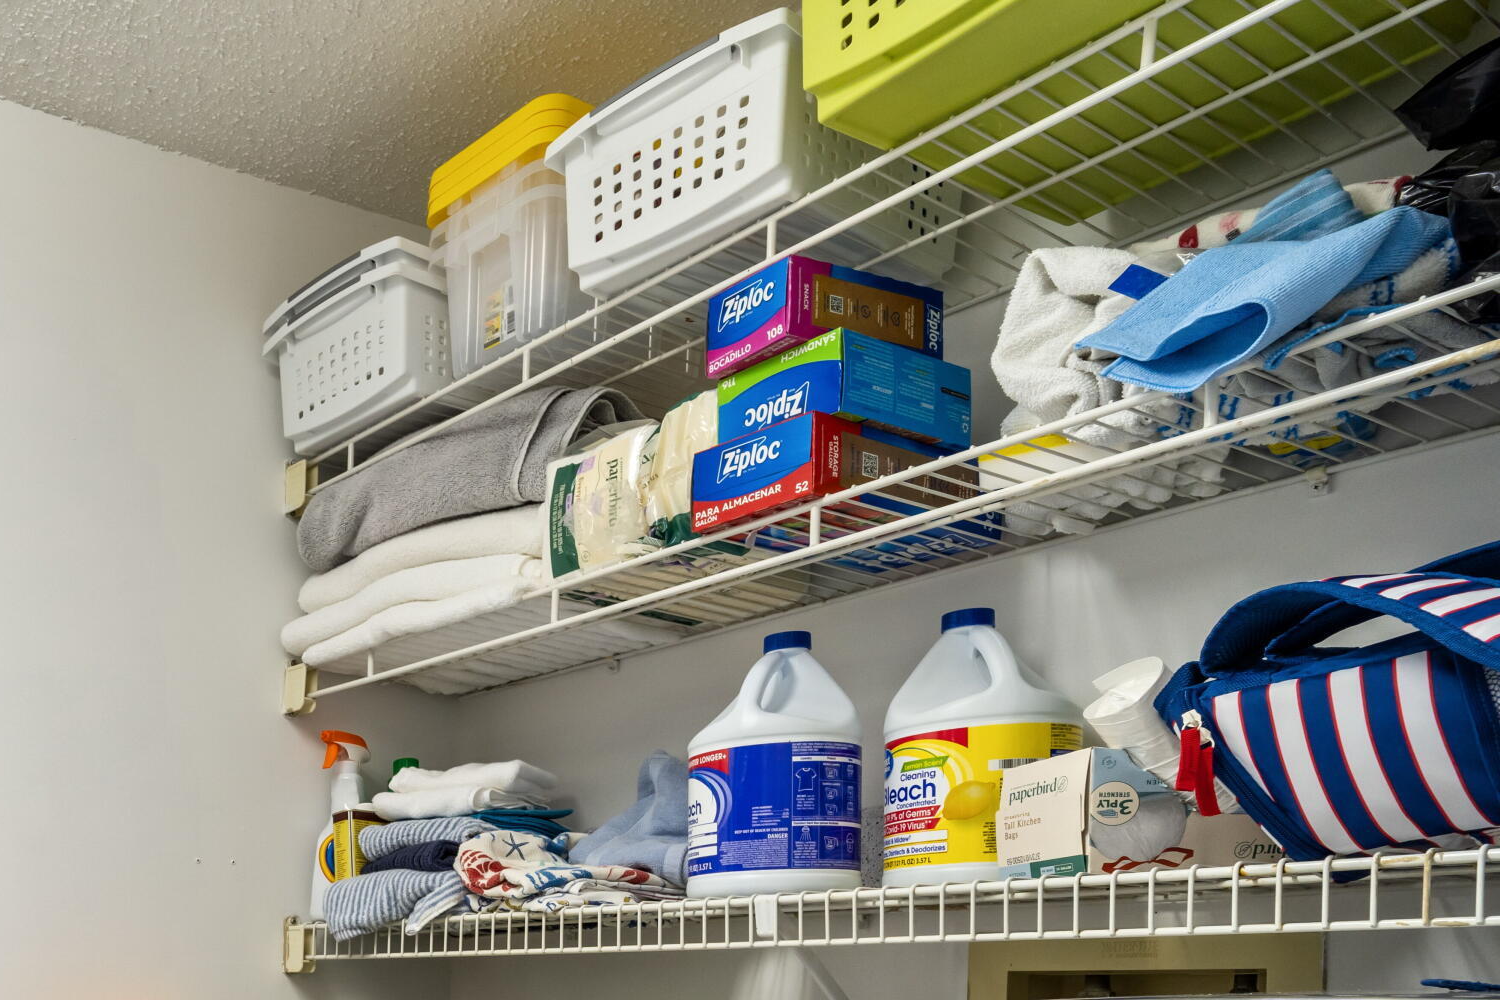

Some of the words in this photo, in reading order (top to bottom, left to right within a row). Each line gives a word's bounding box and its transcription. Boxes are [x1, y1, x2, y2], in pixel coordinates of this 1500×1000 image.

[723, 281, 775, 324] Ziploc
[766, 324, 783, 341] 108
[927, 308, 941, 352] Ziploc
[709, 344, 752, 373] BOCADILLO
[744, 388, 802, 429] Ziploc
[723, 439, 781, 477] Ziploc
[795, 481, 809, 494] 52
[695, 506, 720, 521] PARA
[722, 484, 782, 512] ALMACENAR
[900, 770, 936, 782] Cleaning
[1009, 777, 1057, 806] paperbird
[896, 799, 936, 809] Concentrated
[1097, 800, 1118, 809] PLY
[1119, 799, 1133, 815] 3
[1004, 822, 1015, 831] Tall
[1017, 816, 1041, 828] Kitchen
[1004, 831, 1018, 841] Bags
